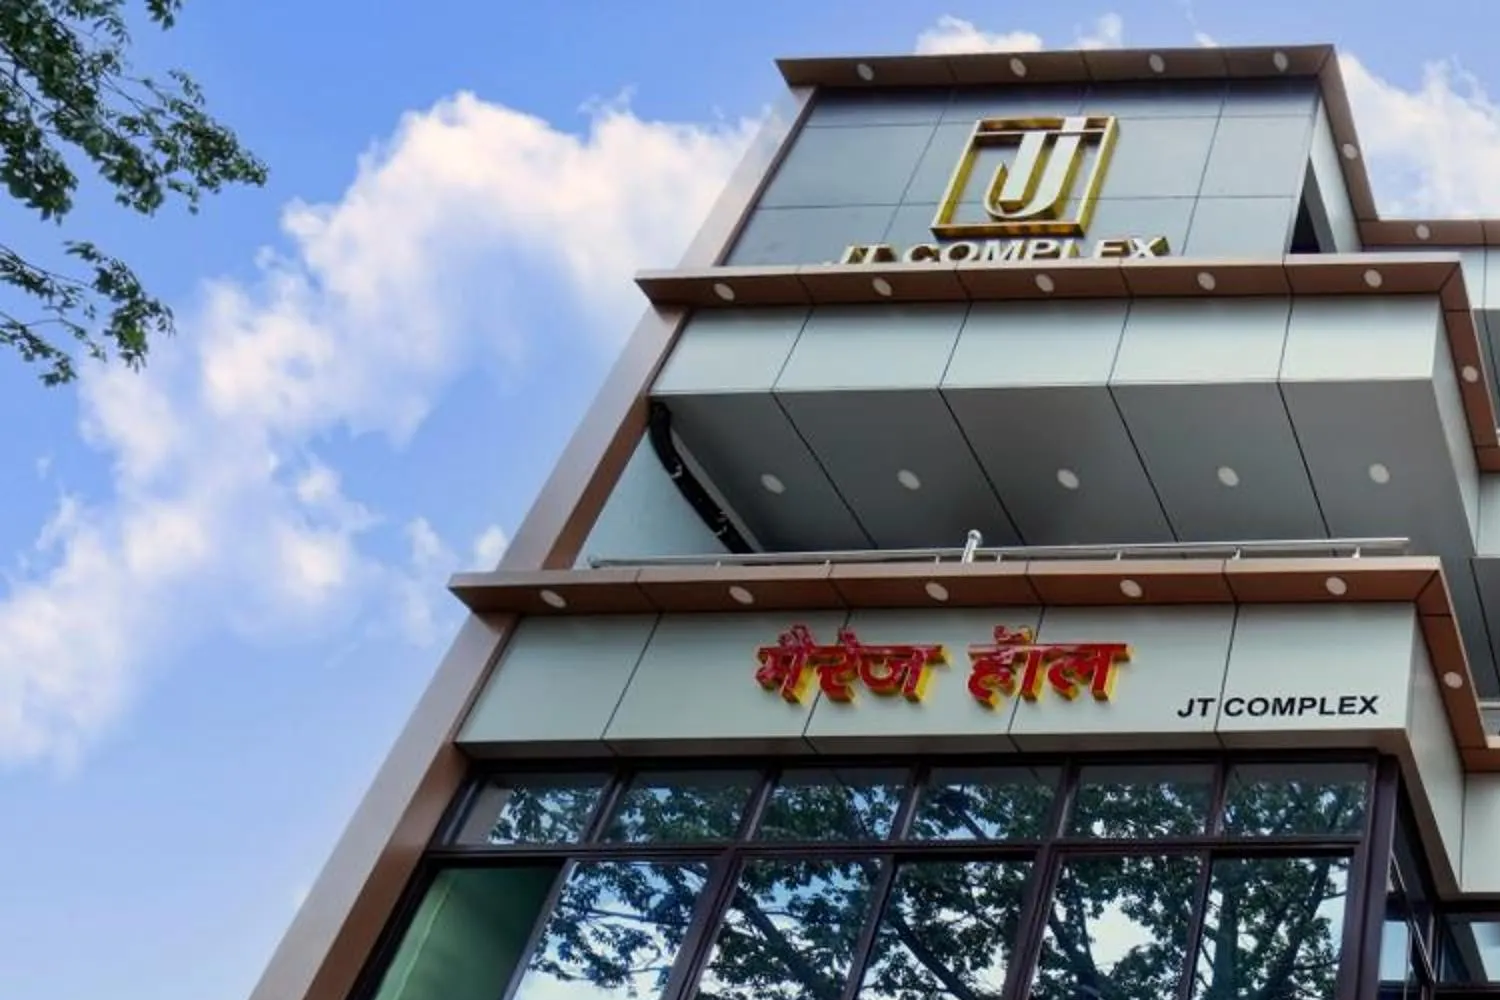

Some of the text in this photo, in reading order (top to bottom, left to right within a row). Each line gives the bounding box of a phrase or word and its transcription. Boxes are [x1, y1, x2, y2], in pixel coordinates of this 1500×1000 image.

[967, 625, 1134, 709] हॉल
[1177, 695, 1379, 718] JT COMPLEX
